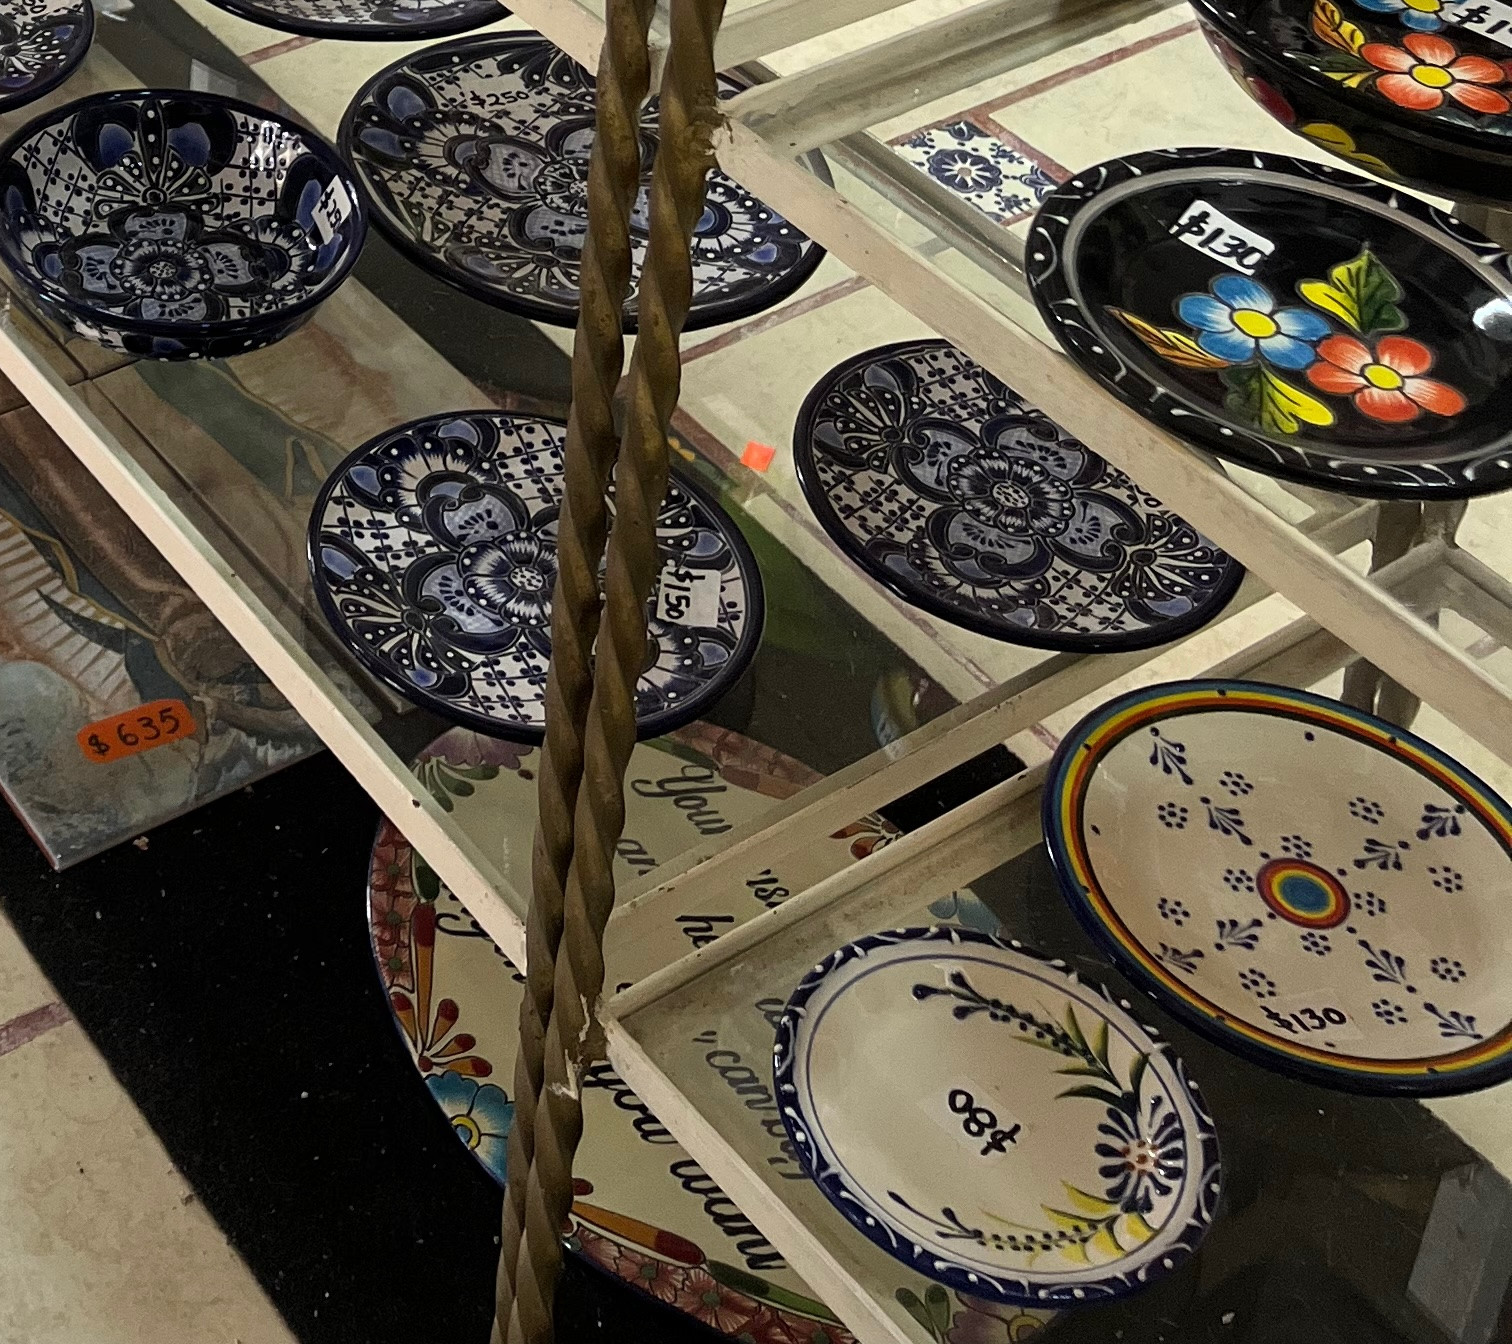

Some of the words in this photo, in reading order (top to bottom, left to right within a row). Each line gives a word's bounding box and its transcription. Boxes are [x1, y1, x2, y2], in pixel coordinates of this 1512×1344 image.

[1452, 5, 1512, 36] $1
[469, 90, 530, 109] $250
[1173, 210, 1268, 269] $130
[664, 568, 706, 620] $150
[1259, 1005, 1348, 1034] $130
[948, 1089, 1022, 1157] $80
